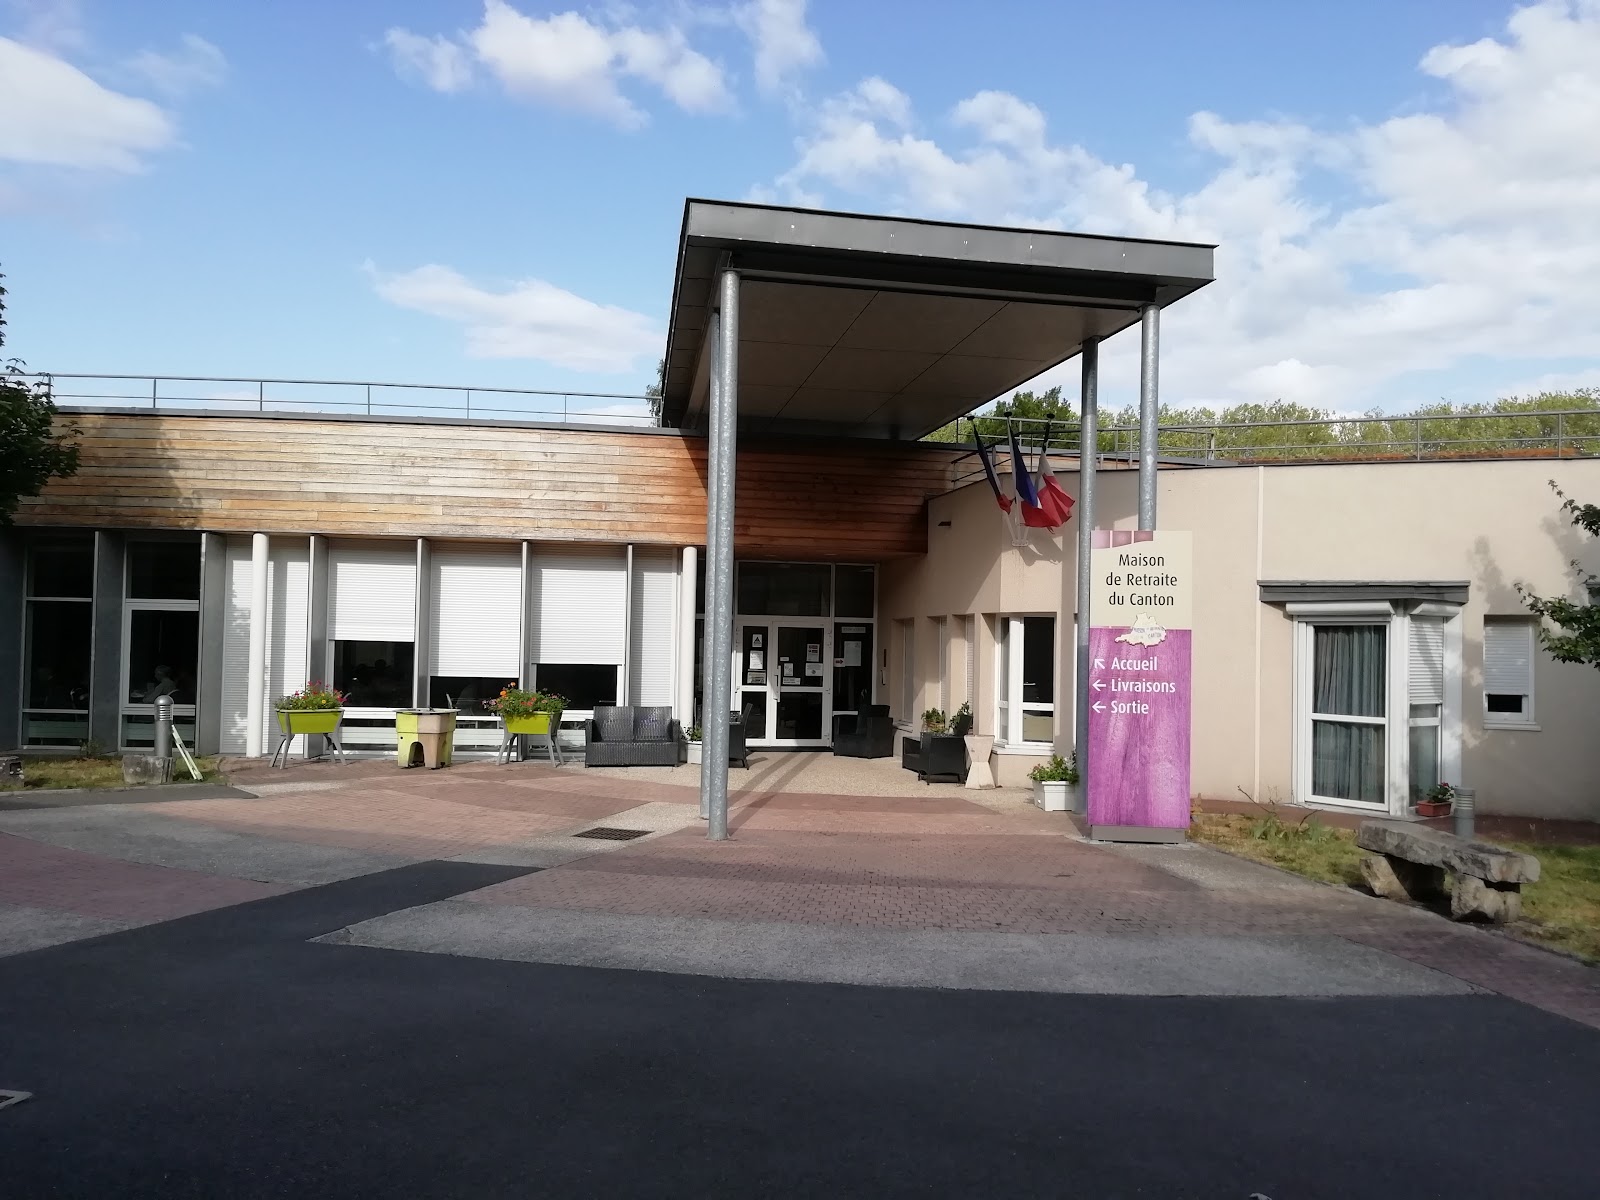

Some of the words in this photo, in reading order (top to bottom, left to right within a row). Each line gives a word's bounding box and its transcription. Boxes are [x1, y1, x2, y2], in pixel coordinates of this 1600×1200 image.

[1118, 553, 1165, 567] Maison
[1106, 572, 1122, 586] de
[1127, 573, 1178, 586] Retraite
[1108, 592, 1124, 606] du
[1129, 593, 1174, 606] Canton
[1111, 656, 1158, 671] Accueil
[1111, 678, 1176, 693] Livraisons
[1110, 700, 1149, 714] Sortie
